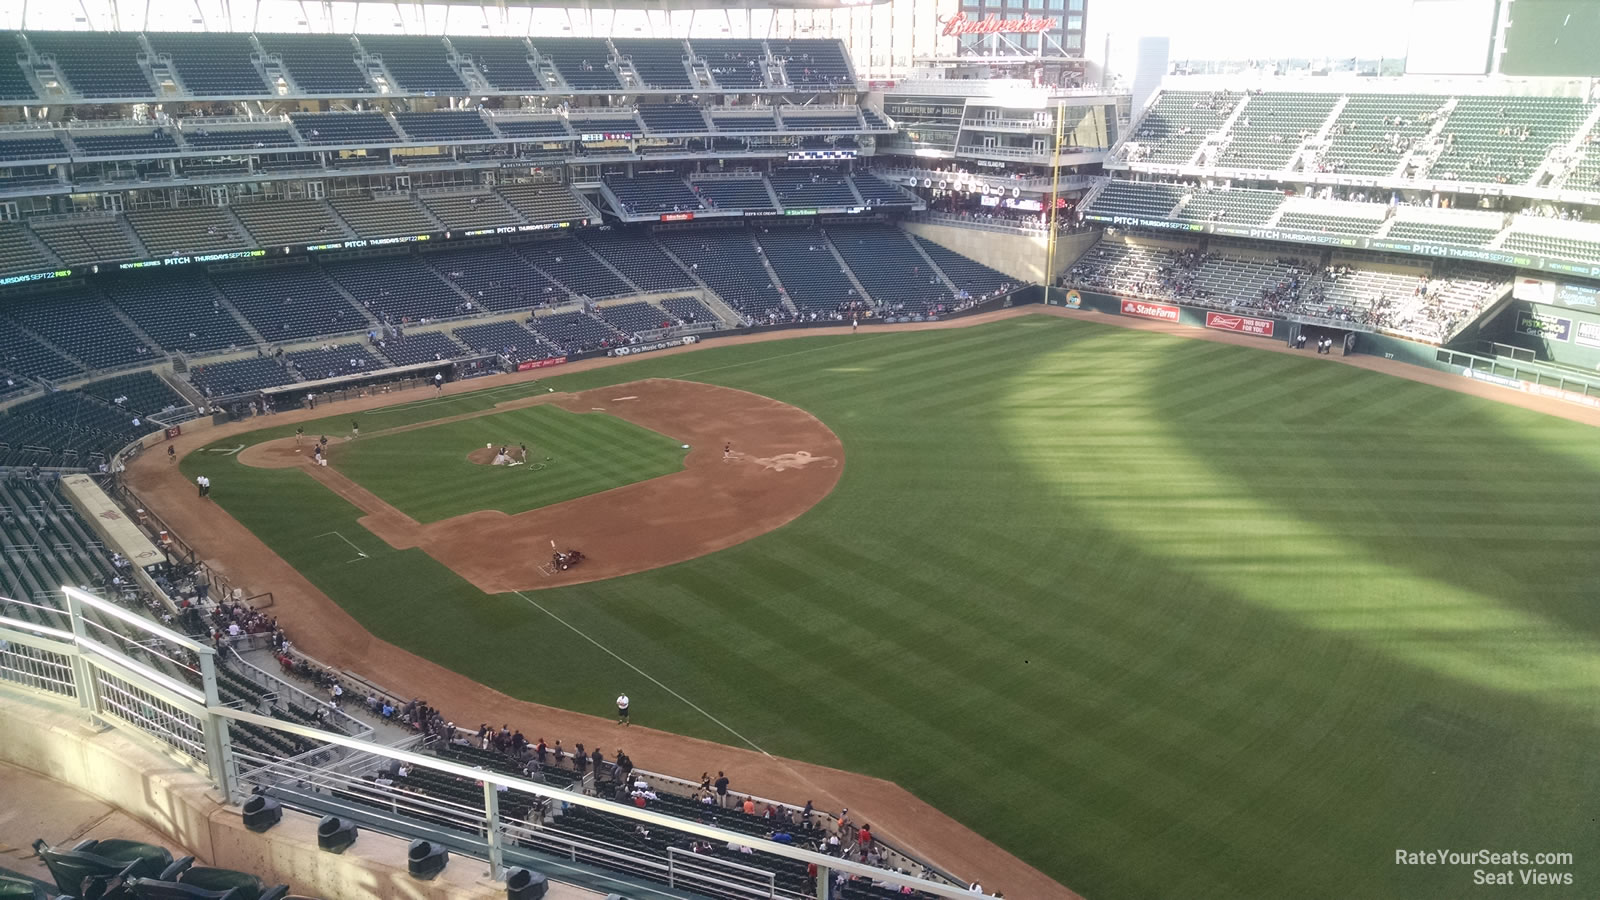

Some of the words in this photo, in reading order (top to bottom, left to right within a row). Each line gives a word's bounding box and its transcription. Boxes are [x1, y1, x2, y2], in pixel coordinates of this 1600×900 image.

[939, 11, 1056, 36] Budweiser
[1114, 216, 1138, 226] PITCH
[1140, 220, 1170, 228] THURSDAYS
[1250, 229, 1280, 239] PITCH
[1281, 233, 1317, 242] THURSDAYS
[164, 257, 190, 265] PITCH
[194, 253, 228, 262] THURSDAYS
[1413, 244, 1447, 256] PITCH
[1450, 249, 1490, 259] THURSDAYS
[1490, 253, 1505, 261] SEPT
[1522, 318, 1565, 334] PISTACHIOS
